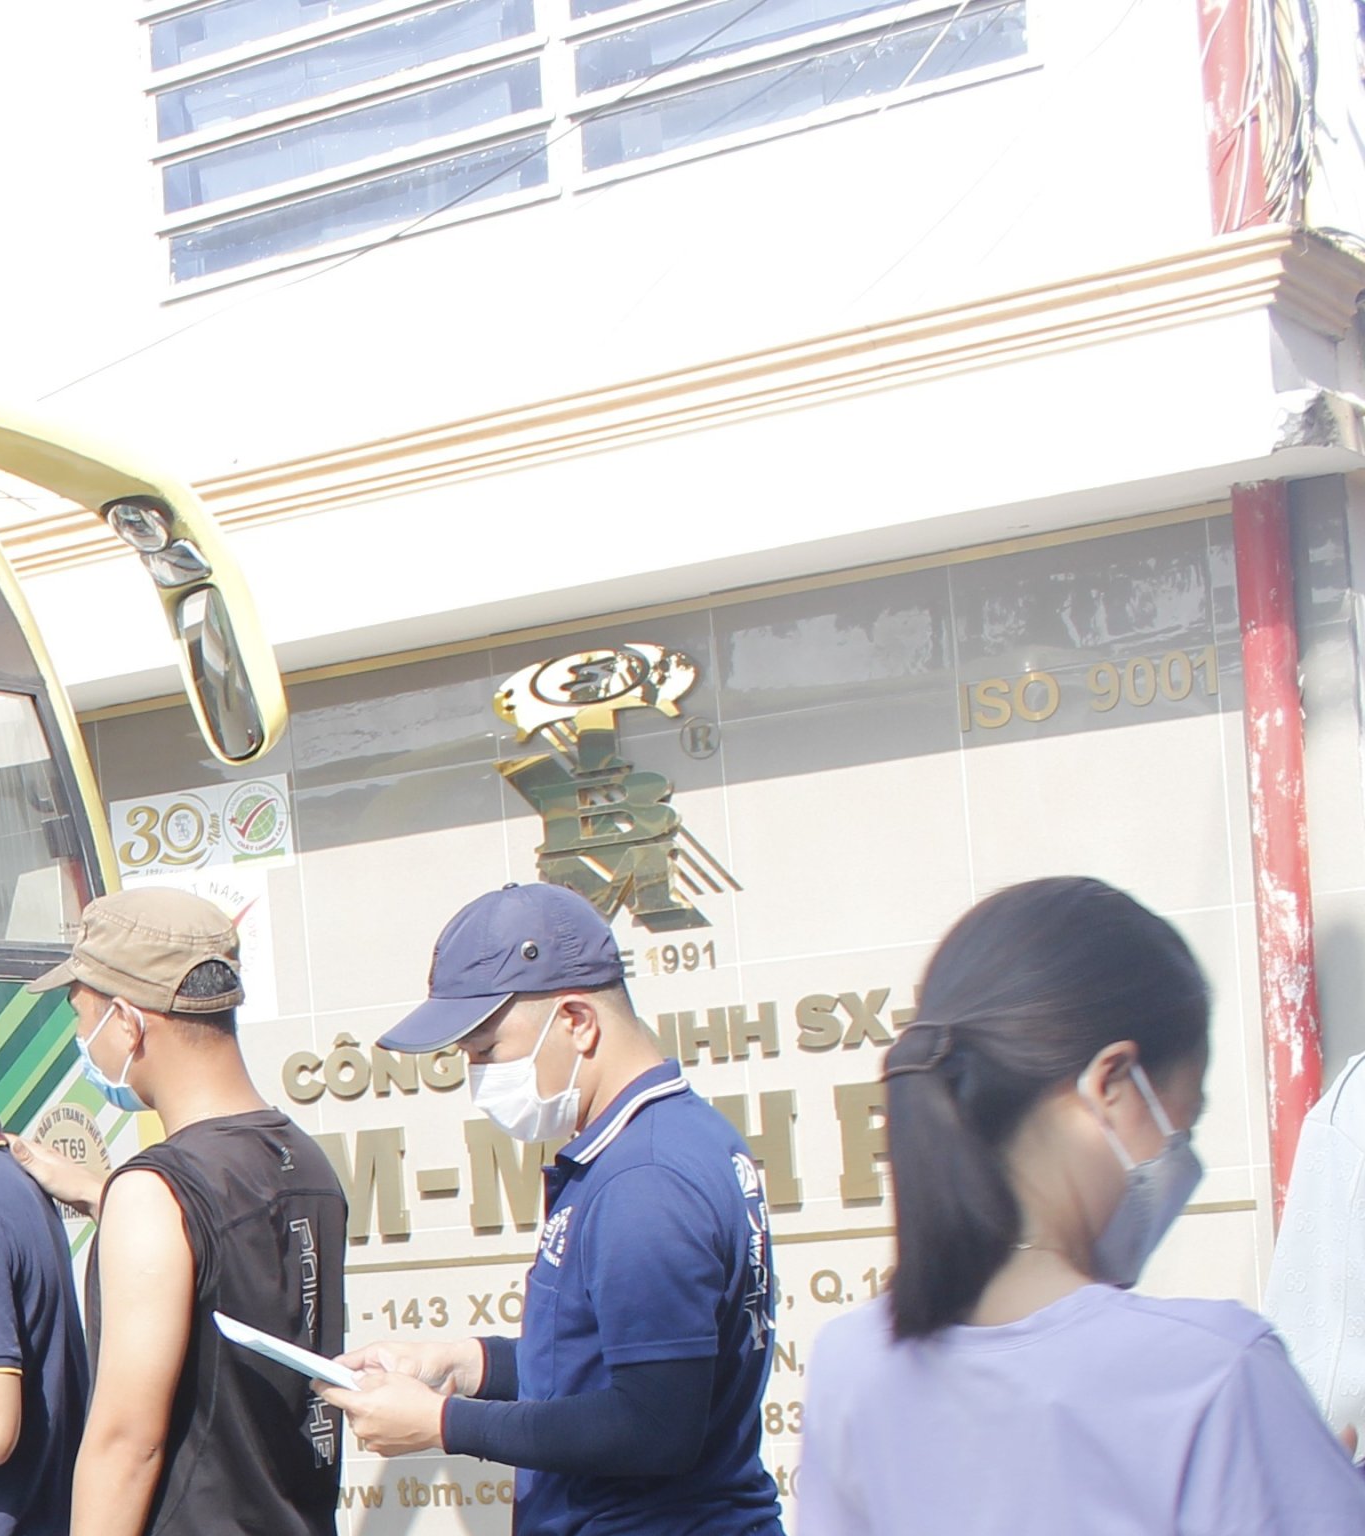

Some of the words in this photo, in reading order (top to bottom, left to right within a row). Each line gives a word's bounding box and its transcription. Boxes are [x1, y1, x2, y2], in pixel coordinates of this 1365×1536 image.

[959, 671, 1062, 733] ISO
[1085, 644, 1219, 712] 9001
[118, 802, 206, 868] 30
[645, 940, 717, 977] 1991
[282, 1032, 466, 1104] CÔNG
[639, 1001, 780, 1067] NHH
[795, 984, 925, 1053] SX-
[467, 1280, 525, 1327] XÓ
